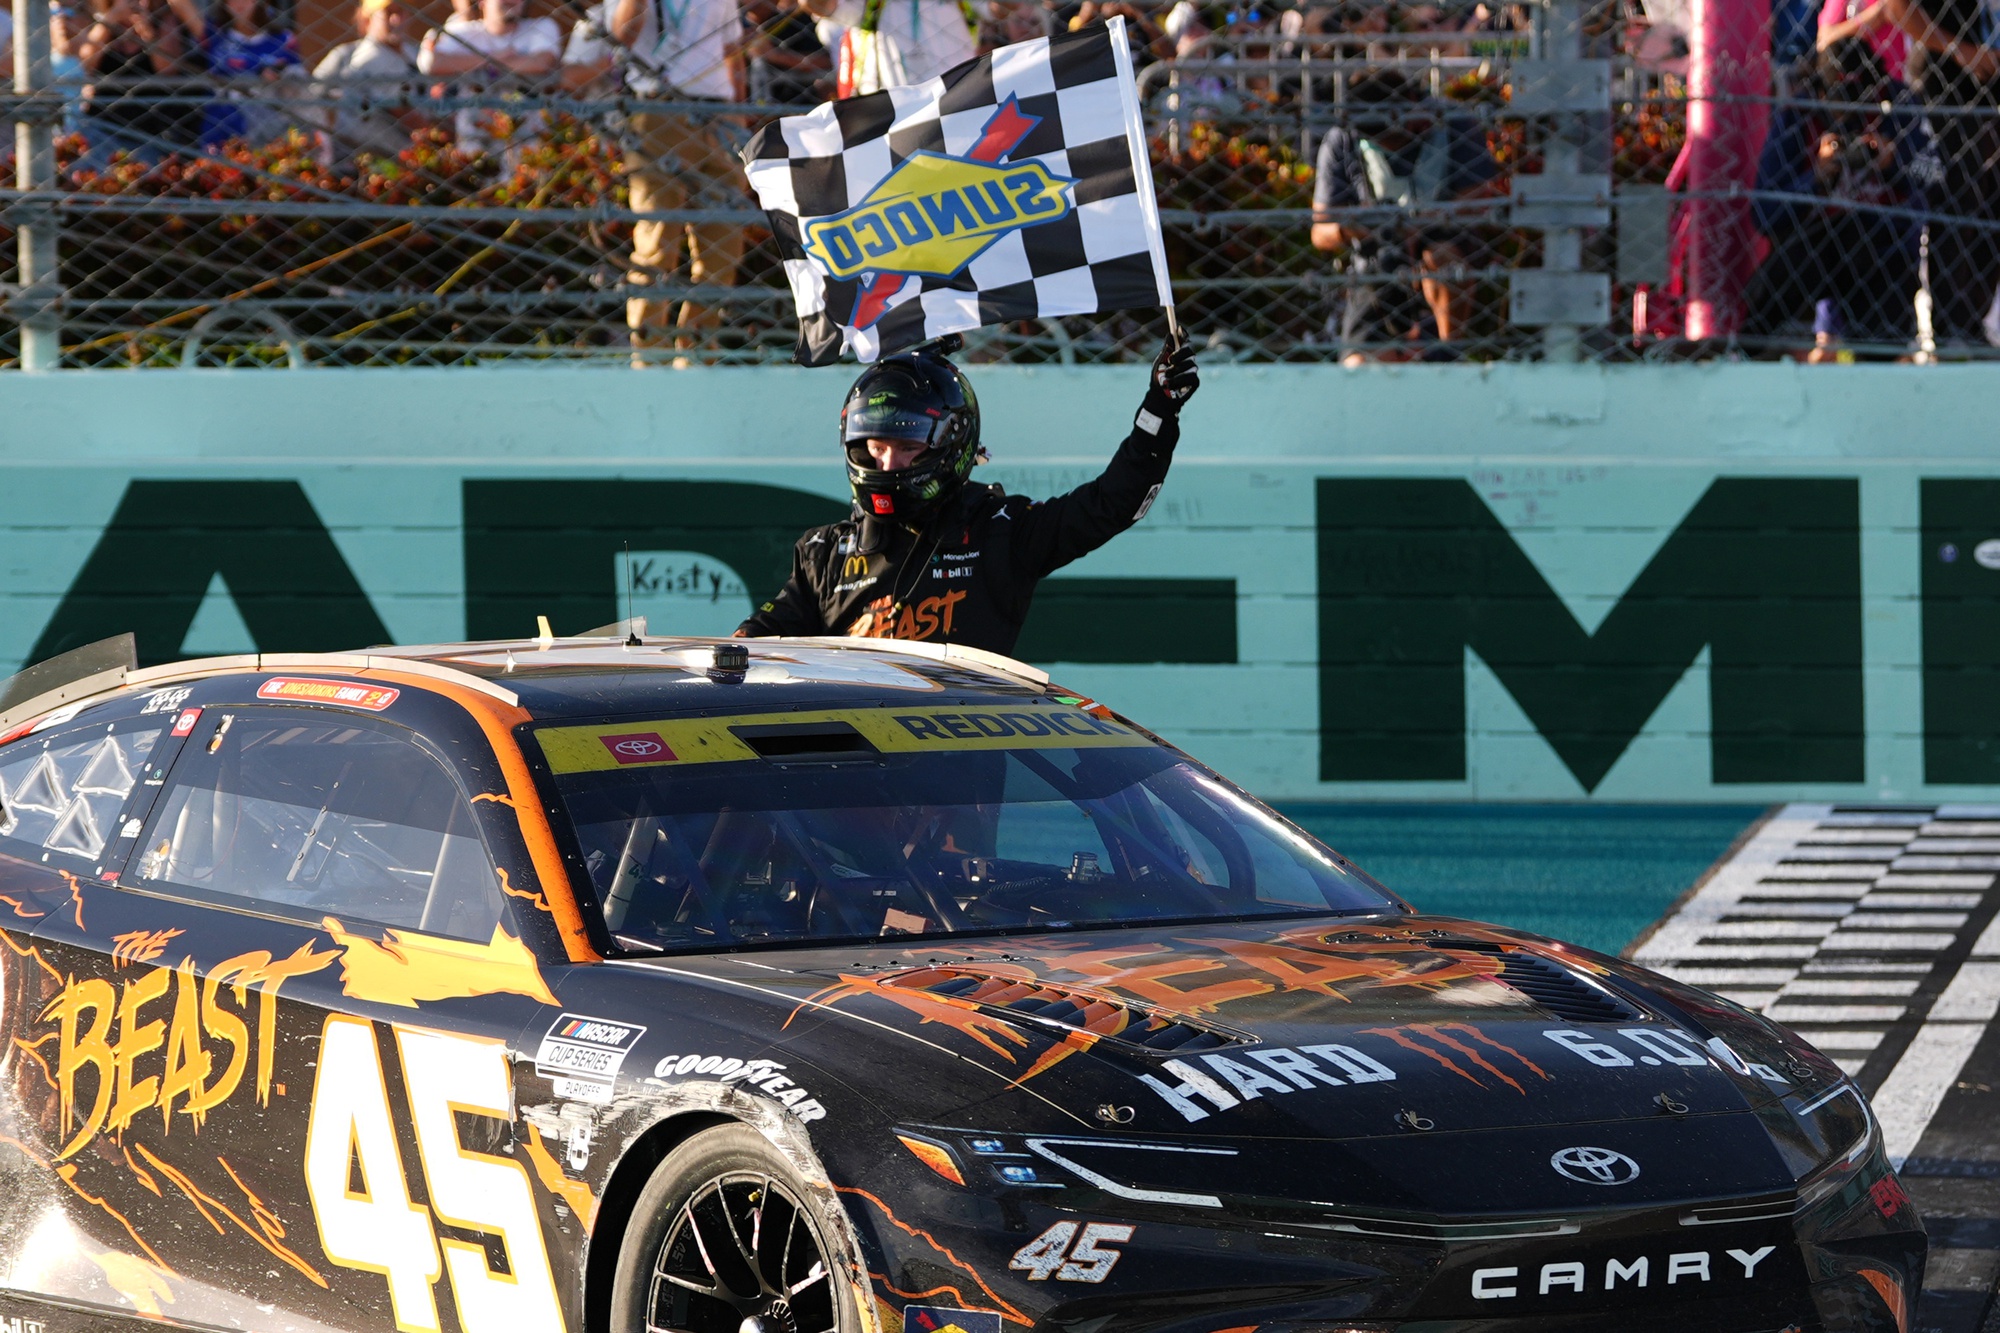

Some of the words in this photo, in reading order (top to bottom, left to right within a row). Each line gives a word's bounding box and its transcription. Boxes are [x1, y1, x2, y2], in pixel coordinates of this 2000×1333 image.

[932, 566, 962, 579] Mobil
[263, 681, 286, 694] THE
[334, 688, 370, 702] FAMILY
[892, 712, 1133, 740] REDDICK
[110, 926, 187, 972] THE
[34, 937, 346, 1162] BEAST
[548, 1046, 574, 1064] CUP
[572, 1049, 612, 1071] SERIES
[574, 1022, 630, 1046] NASCAR
[654, 1054, 827, 1124] GOODYEAR
[1135, 1044, 1397, 1123] HARD
[303, 1013, 570, 1333] 45
[1008, 1220, 1137, 1284] 45
[1471, 1246, 1777, 1299] CAMRY
